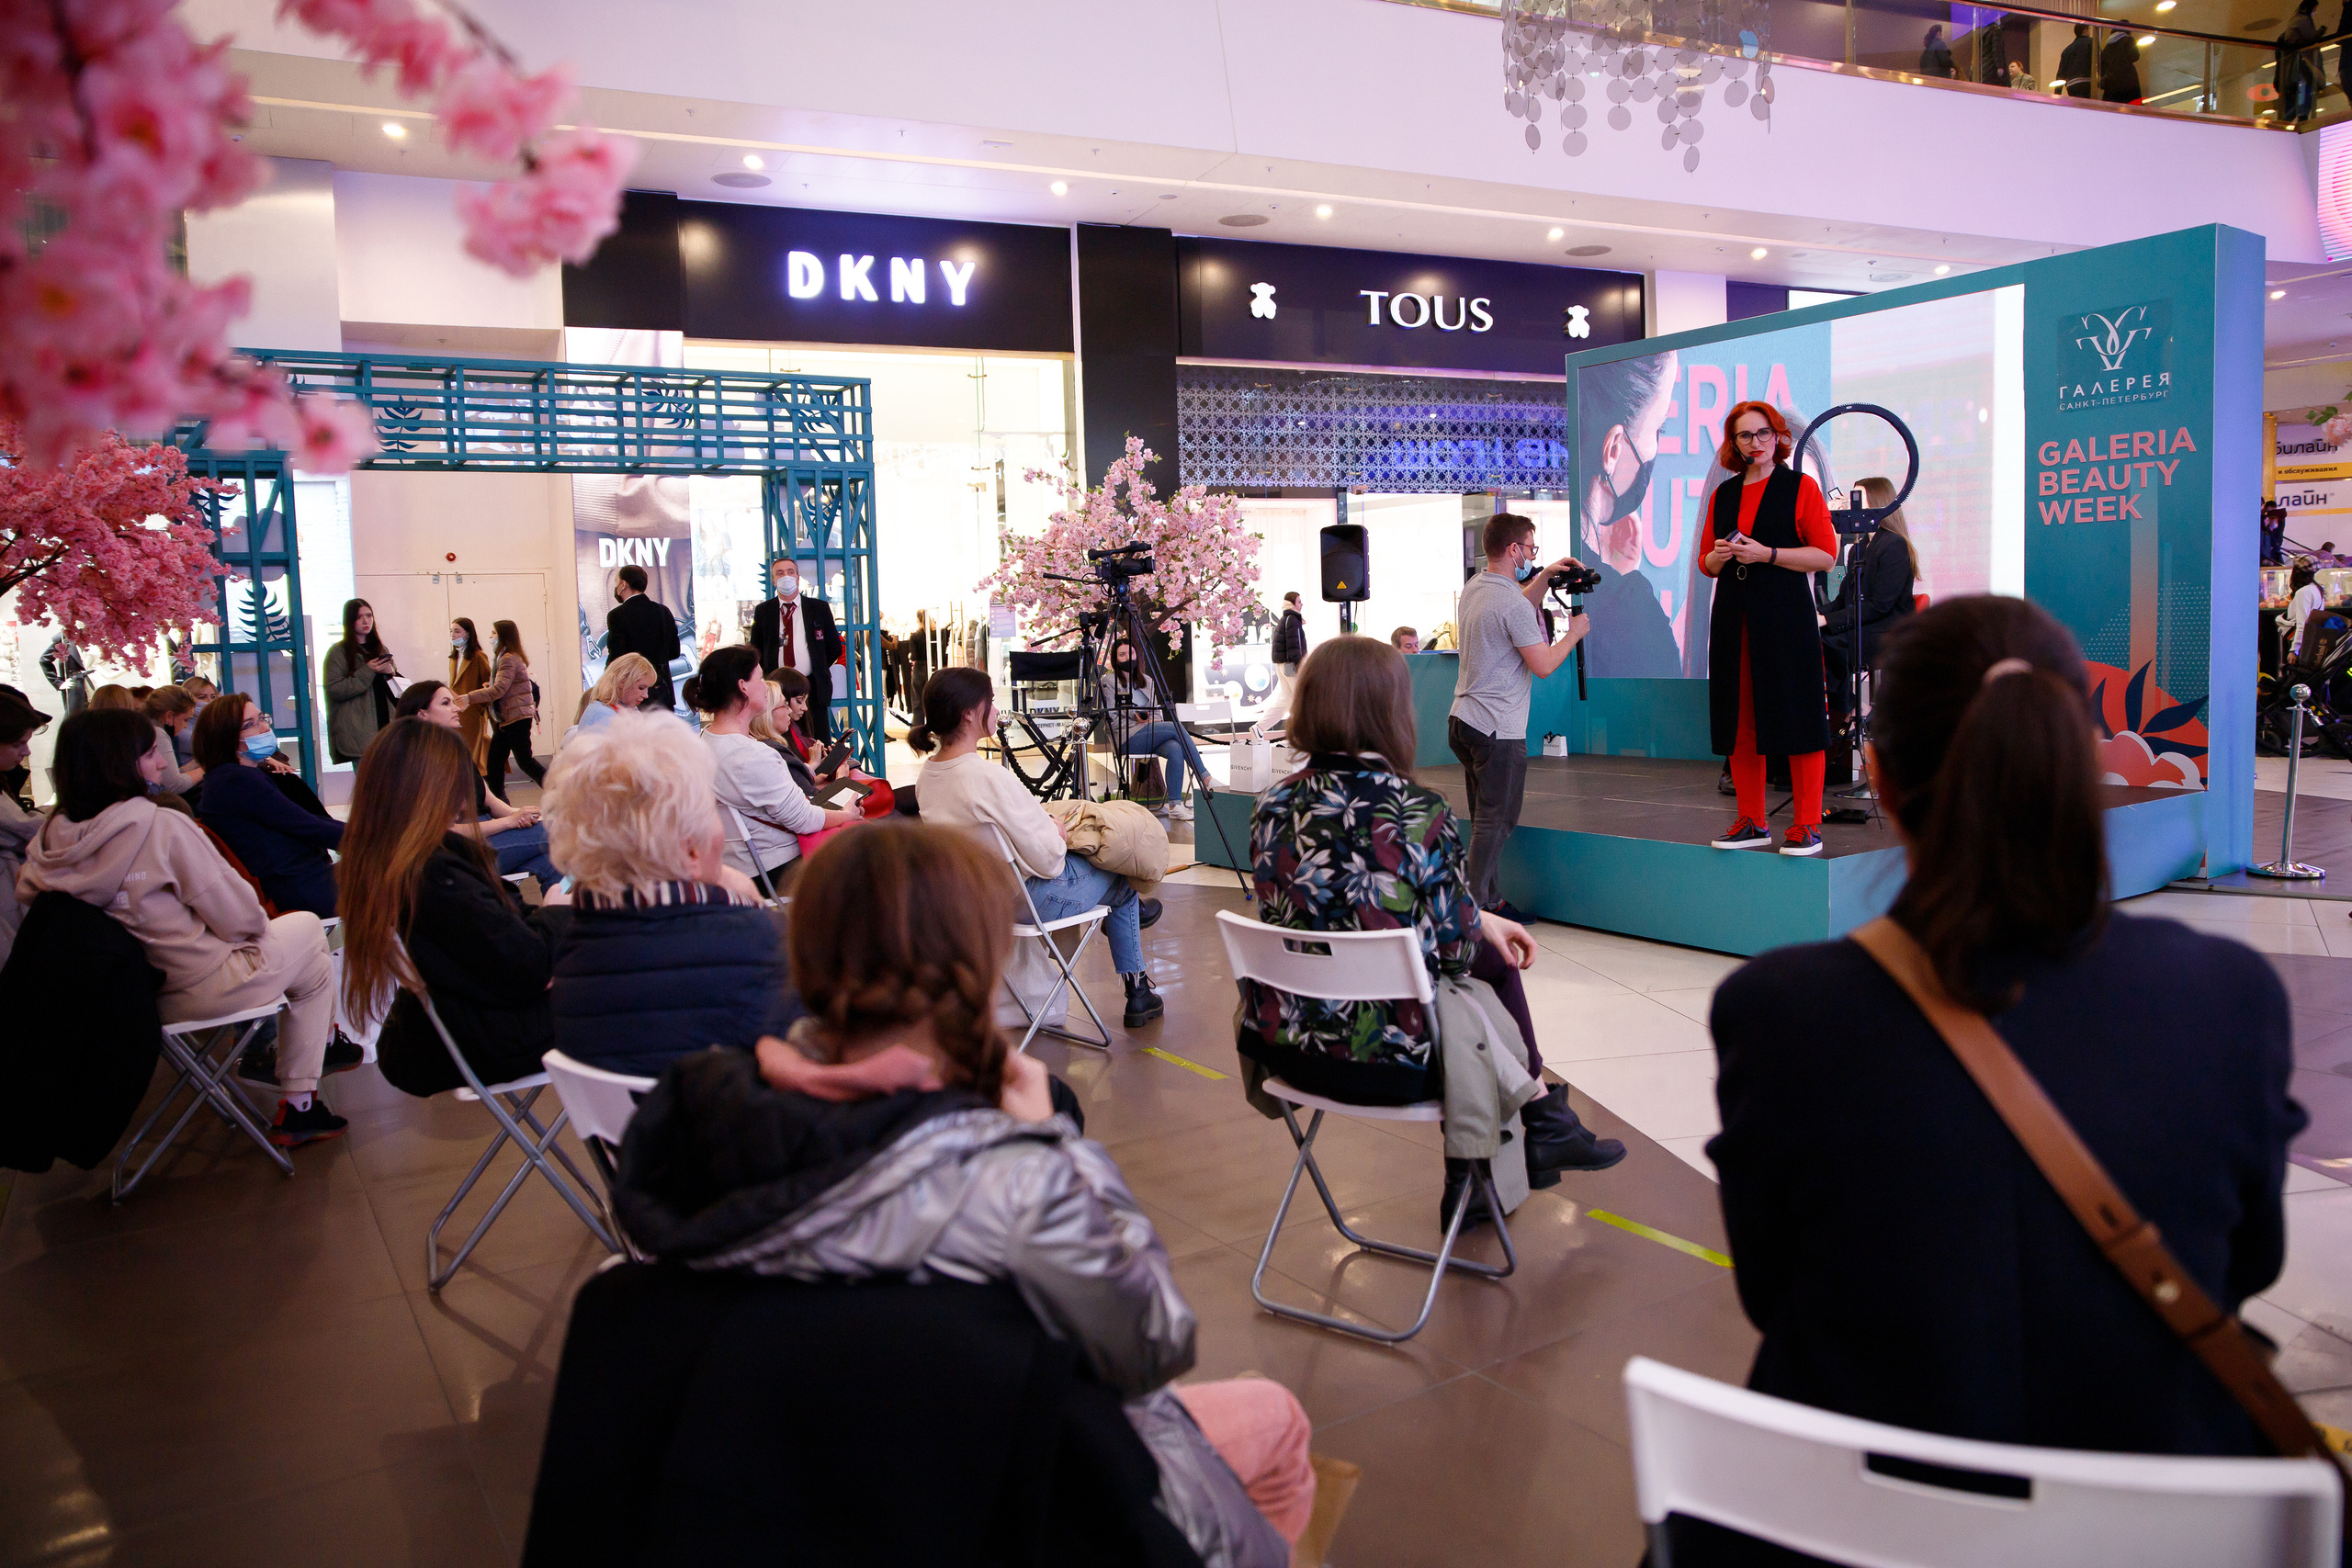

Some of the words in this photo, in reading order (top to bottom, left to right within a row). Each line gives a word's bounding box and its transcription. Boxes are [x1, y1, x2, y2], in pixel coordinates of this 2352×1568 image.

[787, 250, 976, 307] DKNY
[1359, 289, 1494, 333] TOUS
[2059, 372, 2171, 400] ГАЛЕРЕЯ
[2059, 389, 2170, 412] САНКТ-ПЕТЕРБУРГ
[2038, 426, 2197, 467] GALERIA
[2039, 458, 2181, 497] BEAUTY
[2284, 466, 2338, 475] обслуживания
[2038, 493, 2143, 525] WEEK
[598, 537, 671, 568] DKNY
